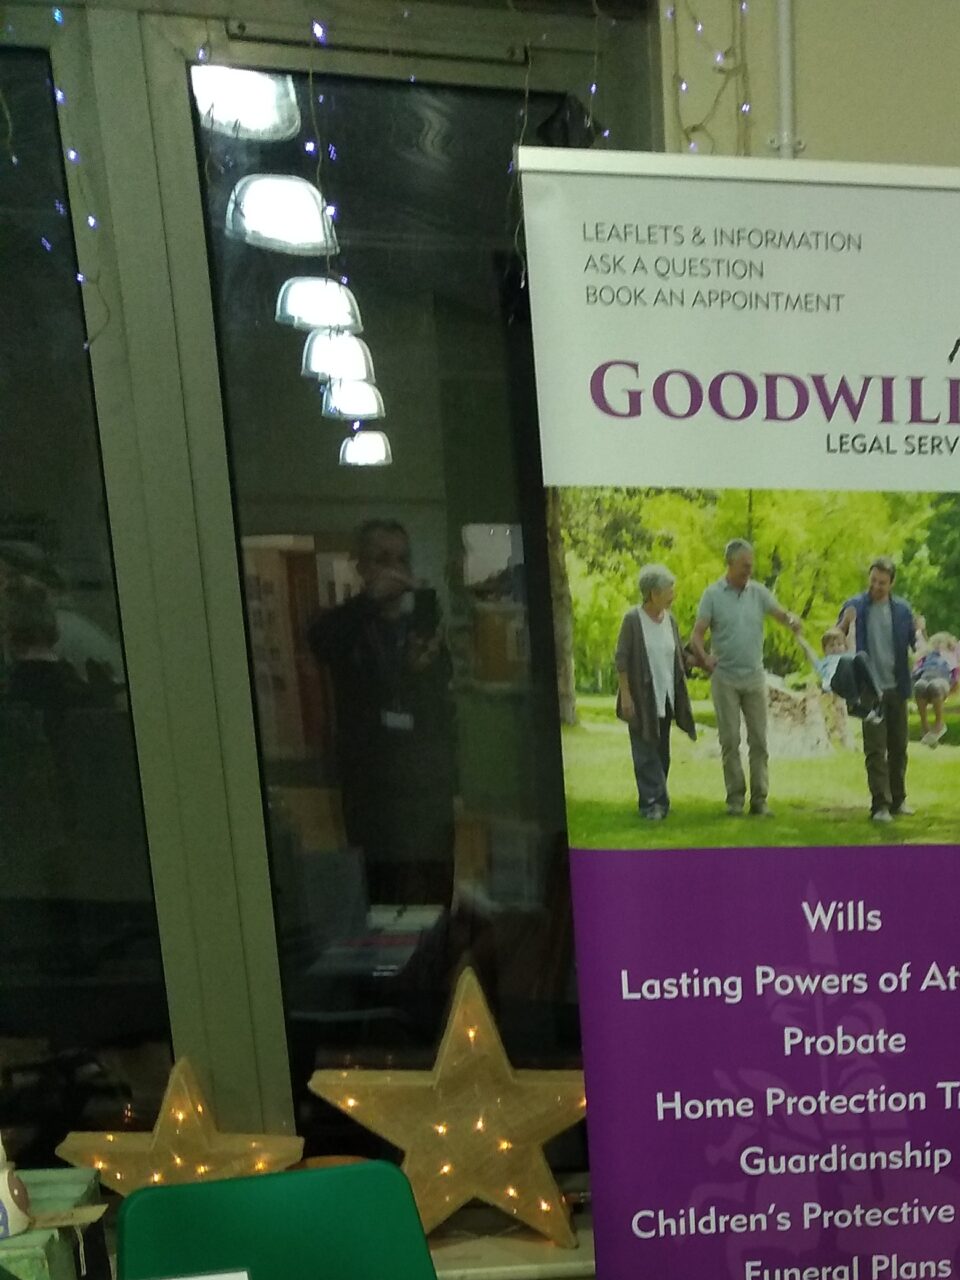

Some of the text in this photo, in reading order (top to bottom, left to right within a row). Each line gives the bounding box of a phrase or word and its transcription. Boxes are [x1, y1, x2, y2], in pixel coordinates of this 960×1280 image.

[582, 222, 862, 252] LEAFLETS & INFORMATION
[583, 254, 764, 280] ASK A QUESTION
[586, 286, 844, 313] BOOK AN APPOINTMENT
[826, 434, 896, 455] LEGAL
[802, 901, 882, 933] Wills
[621, 968, 743, 1003] Lasting
[755, 965, 868, 997] Powers
[879, 962, 911, 993] of
[784, 1026, 907, 1056] Probate
[656, 1092, 754, 1121] Home
[767, 1085, 927, 1116] Protection
[740, 1141, 952, 1176] Guardianship
[631, 1204, 791, 1240] Children's
[803, 1200, 955, 1230] Protective
